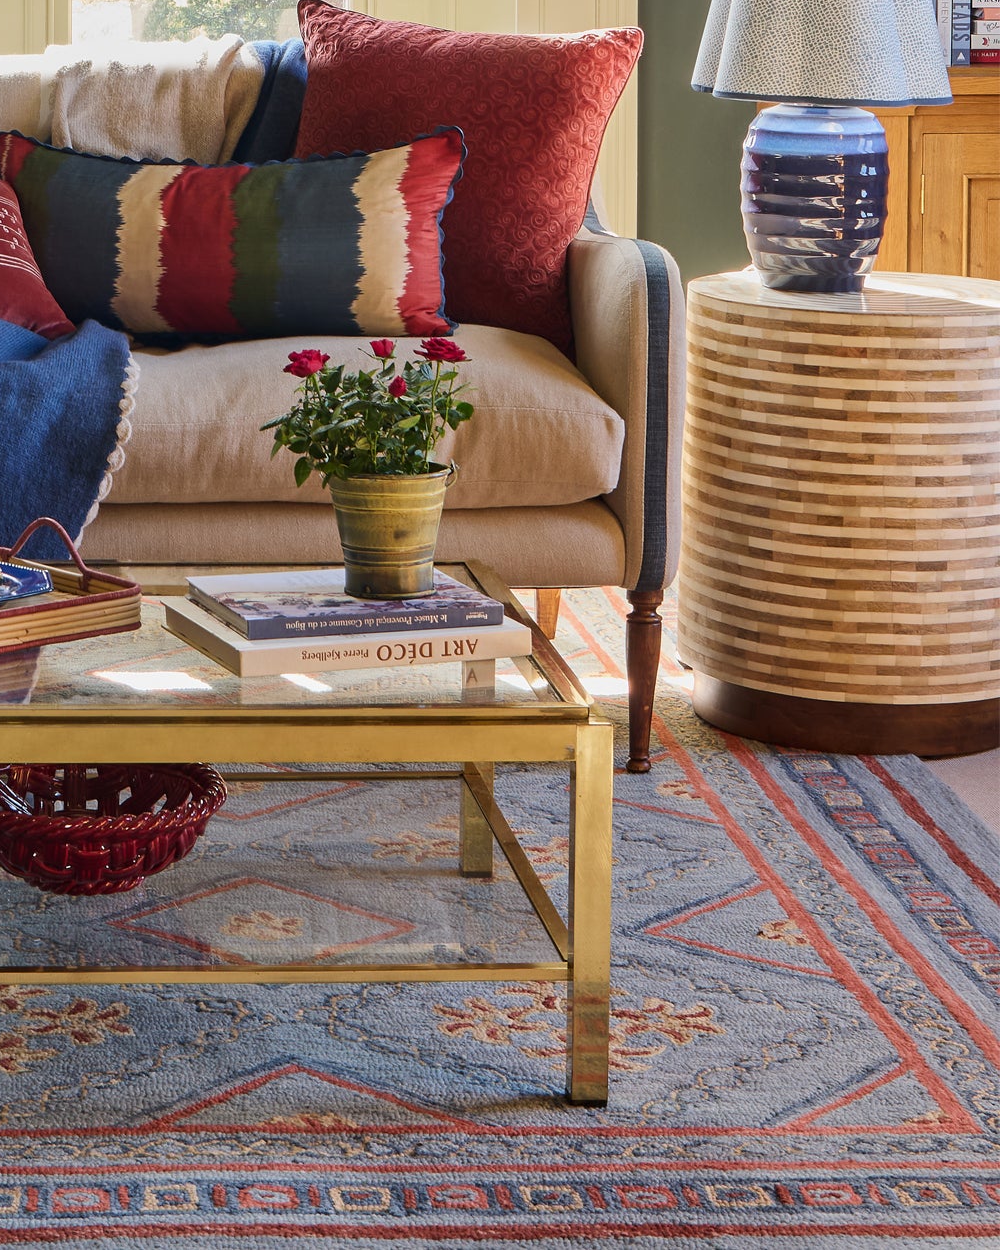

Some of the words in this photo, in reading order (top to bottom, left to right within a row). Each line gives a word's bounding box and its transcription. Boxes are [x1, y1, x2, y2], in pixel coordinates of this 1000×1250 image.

[329, 619, 362, 628] Costume
[364, 618, 375, 626] du
[376, 616, 412, 627] Provençal
[414, 614, 439, 623] Musée
[285, 621, 306, 631] Bijou
[376, 642, 433, 663] DÉCO
[441, 639, 479, 657] ART
[302, 650, 342, 662] Kjellberg
[343, 649, 369, 658] Pierre
